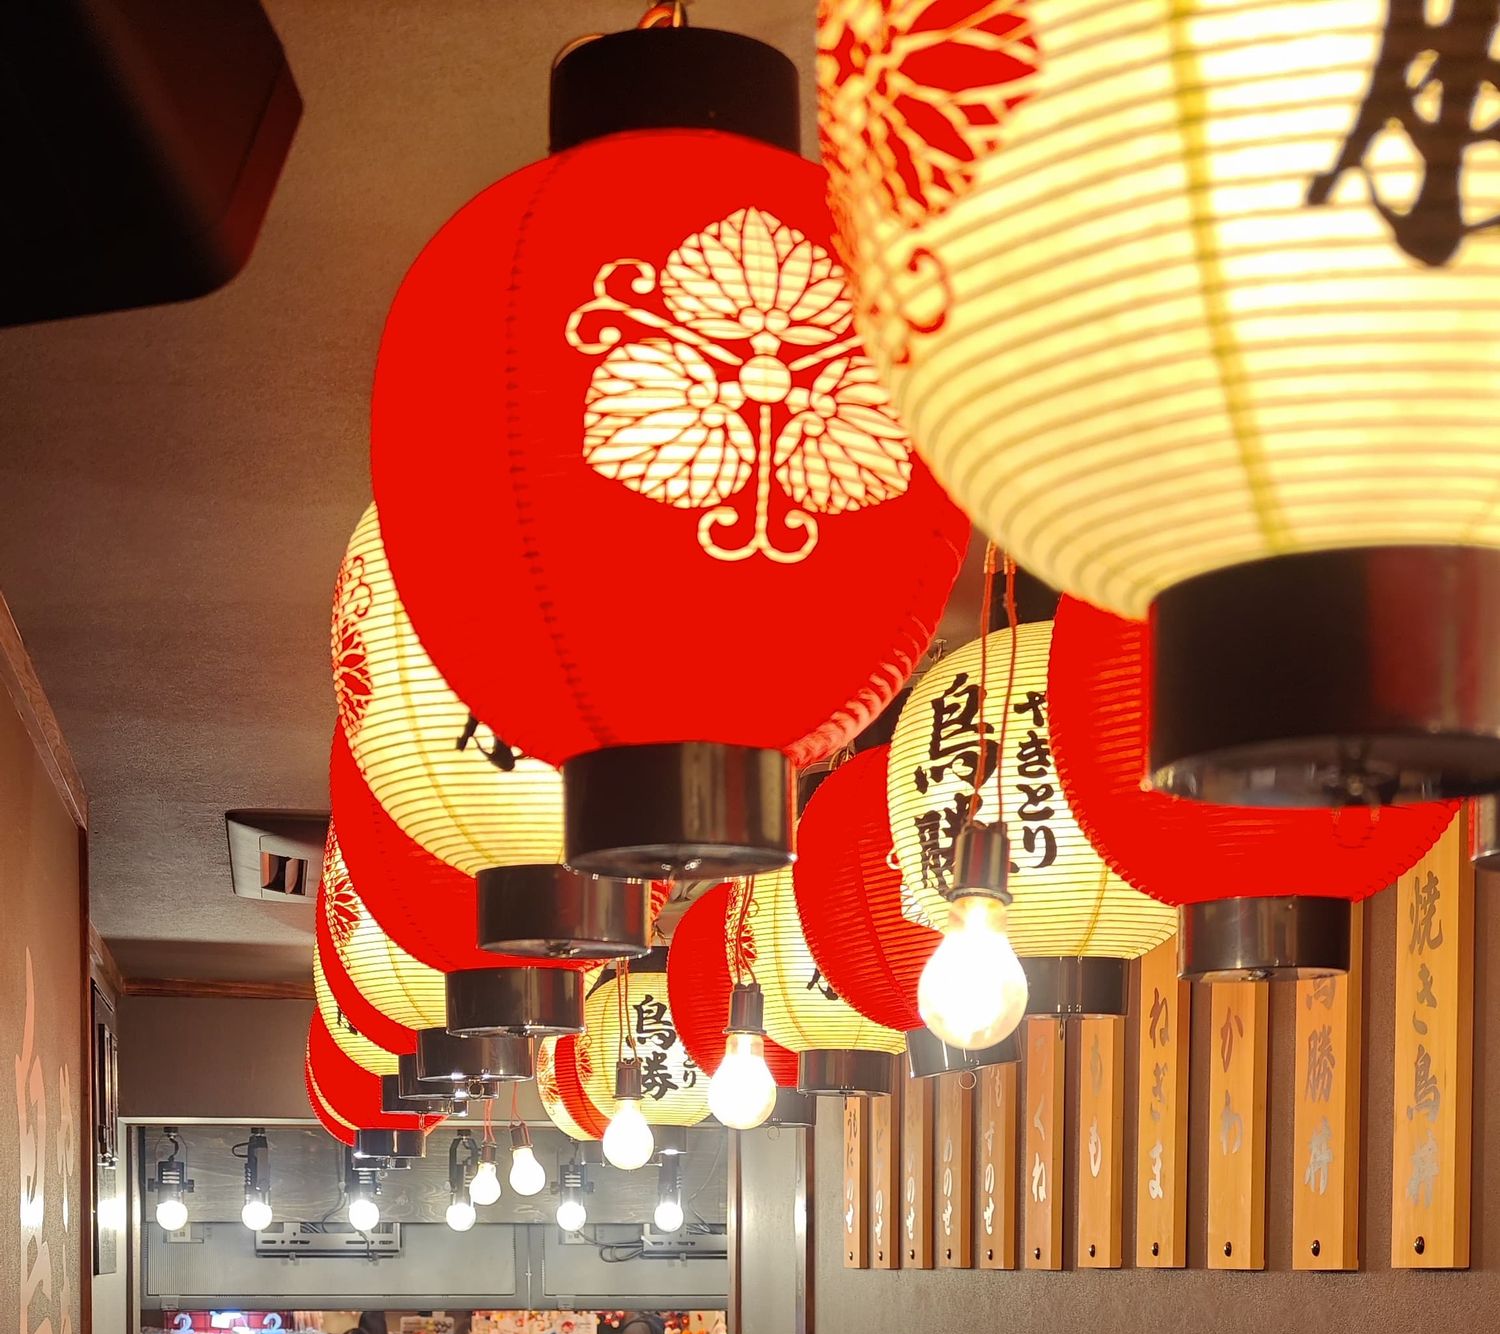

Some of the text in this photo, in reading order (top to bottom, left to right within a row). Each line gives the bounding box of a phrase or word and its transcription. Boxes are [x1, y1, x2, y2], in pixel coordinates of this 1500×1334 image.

[1014, 690, 1057, 869] やきとり
[1032, 1035, 1048, 1203] つくね
[1088, 1033, 1104, 1178] もも
[1148, 988, 1170, 1200] ねぎま
[1220, 1006, 1244, 1155] かわ
